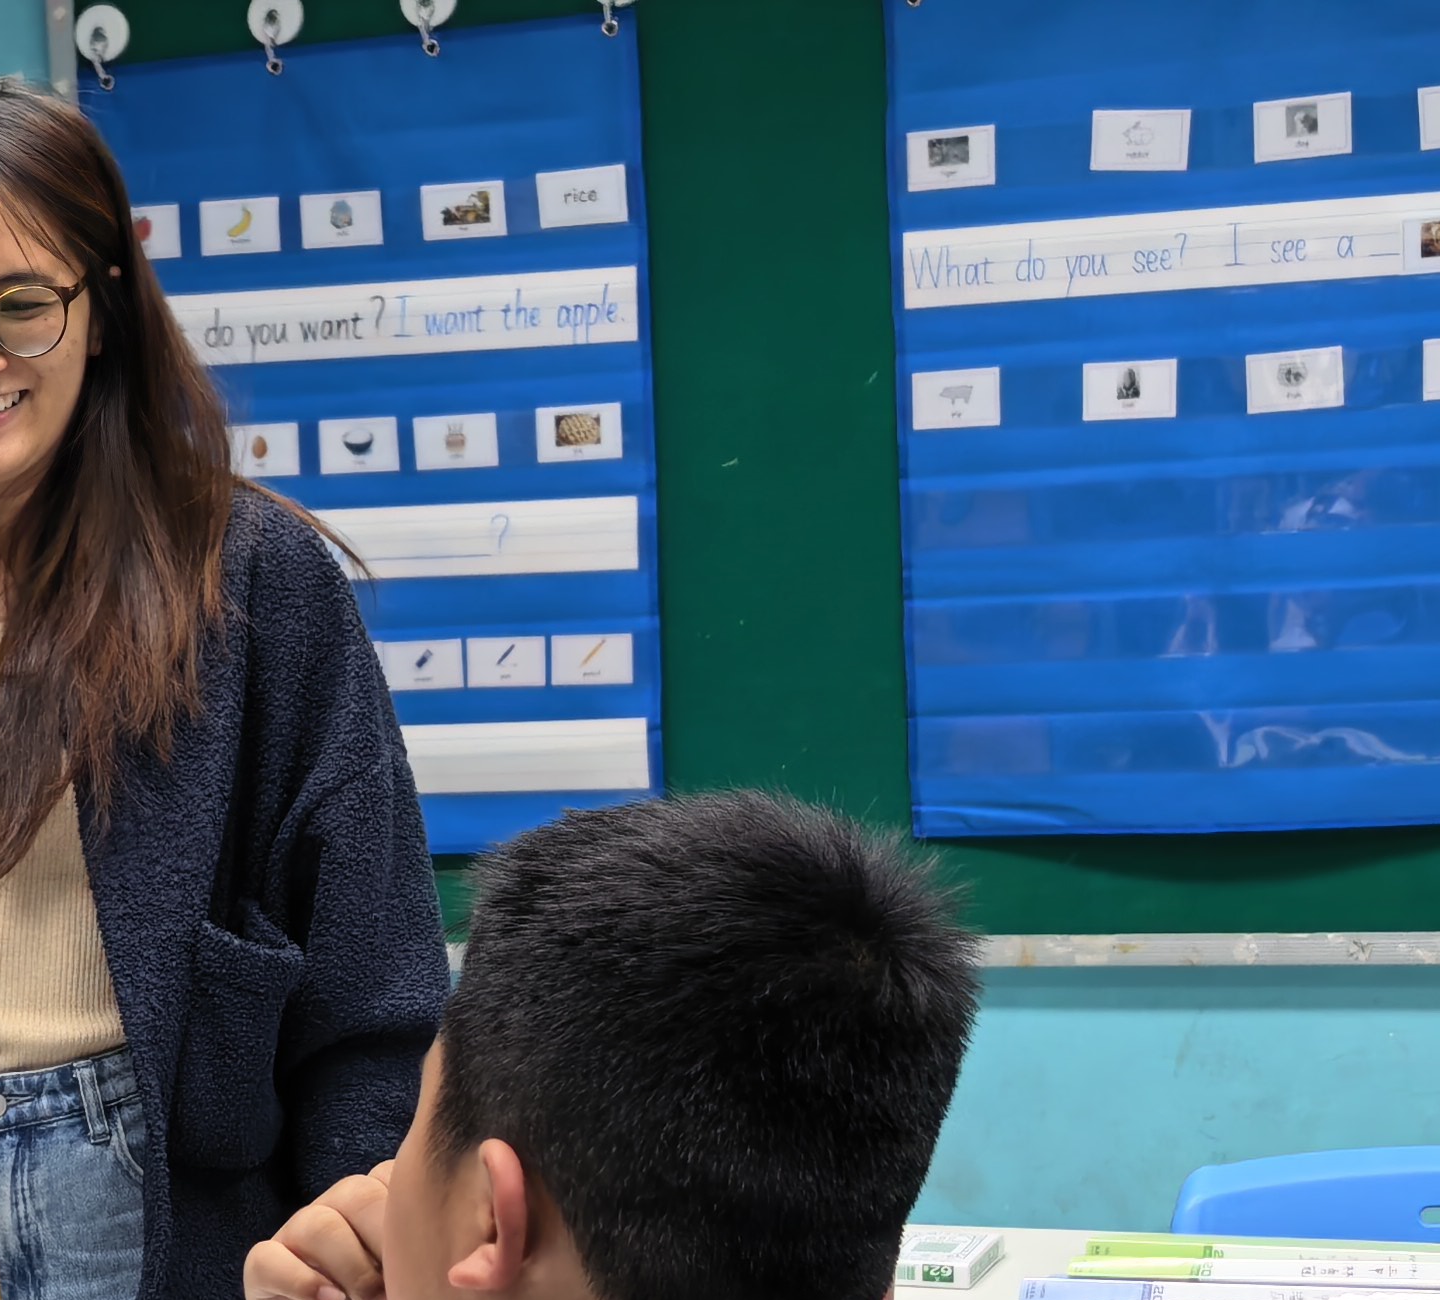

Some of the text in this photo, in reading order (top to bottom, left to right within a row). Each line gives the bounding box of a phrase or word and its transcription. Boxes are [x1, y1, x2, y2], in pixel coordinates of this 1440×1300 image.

[909, 222, 1355, 299] What do you see? I see a
[204, 308, 234, 348] do
[245, 321, 289, 364] you
[392, 294, 418, 338] I
[424, 304, 486, 337] want
[500, 287, 542, 331] the
